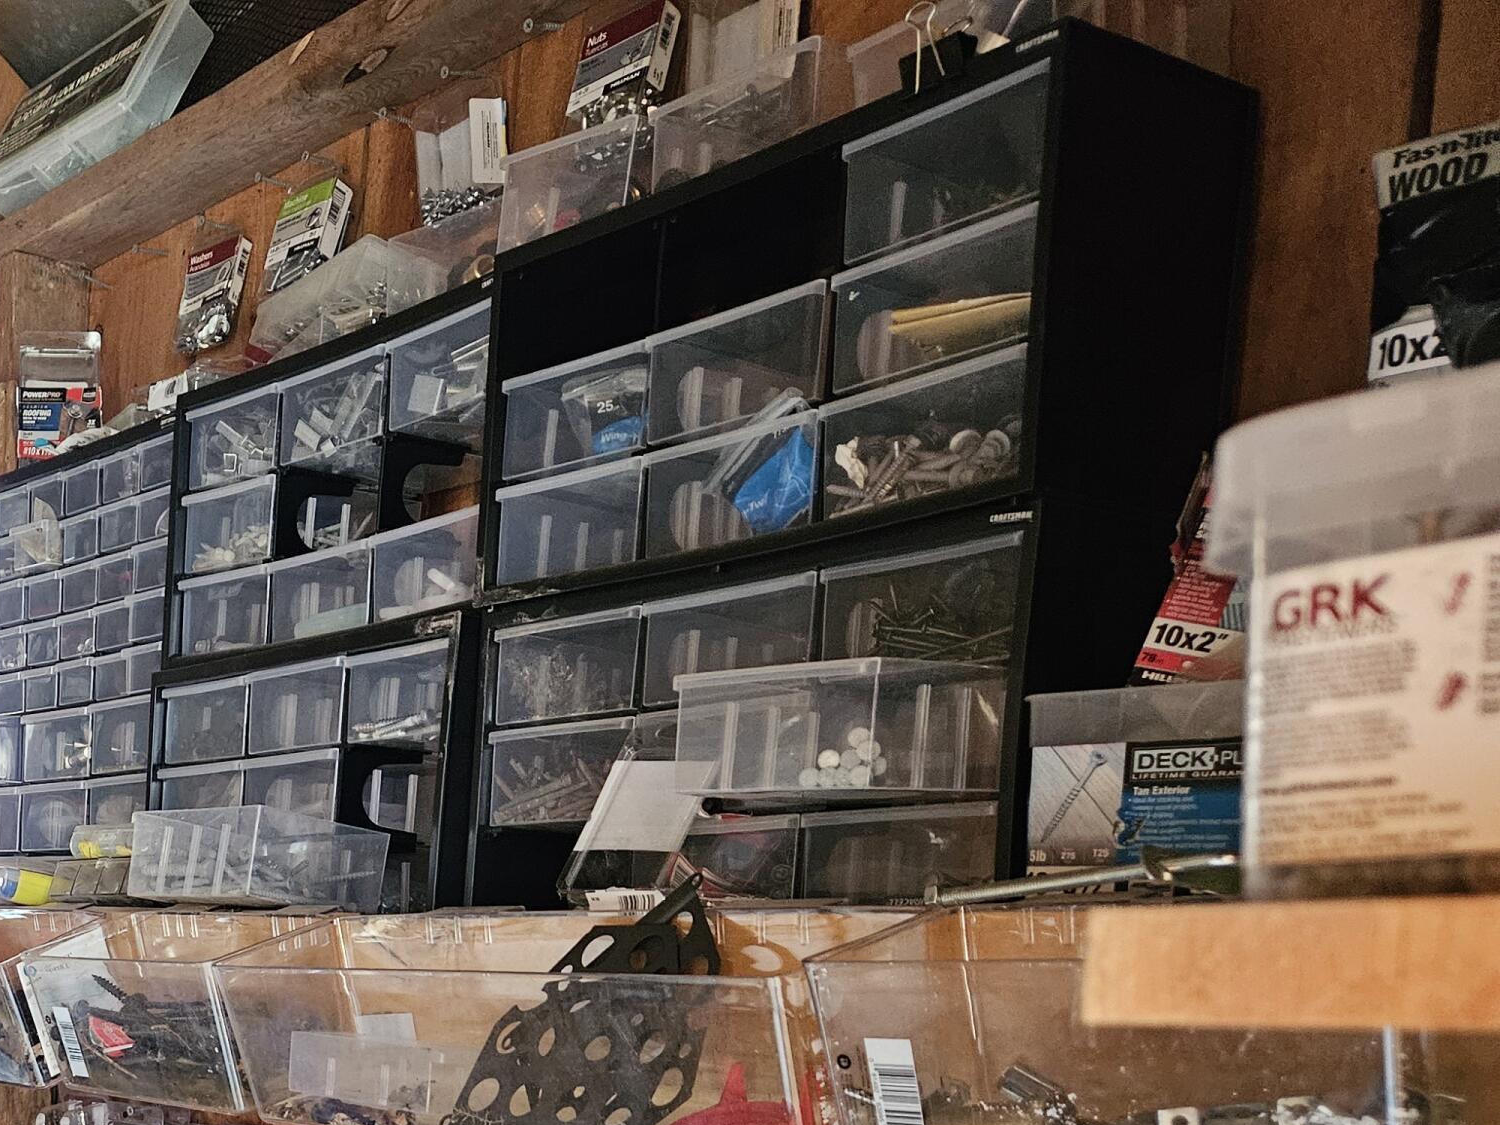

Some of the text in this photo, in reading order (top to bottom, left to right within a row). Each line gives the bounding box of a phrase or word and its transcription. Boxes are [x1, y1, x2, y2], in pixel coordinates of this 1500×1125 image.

[587, 31, 608, 48] Nuts
[1388, 152, 1489, 202] WOOD
[1273, 572, 1392, 633] GRK
[1137, 750, 1209, 771] DECK
[1131, 771, 1187, 780] LIFETIME
[1132, 784, 1191, 797] Tan Exterior
